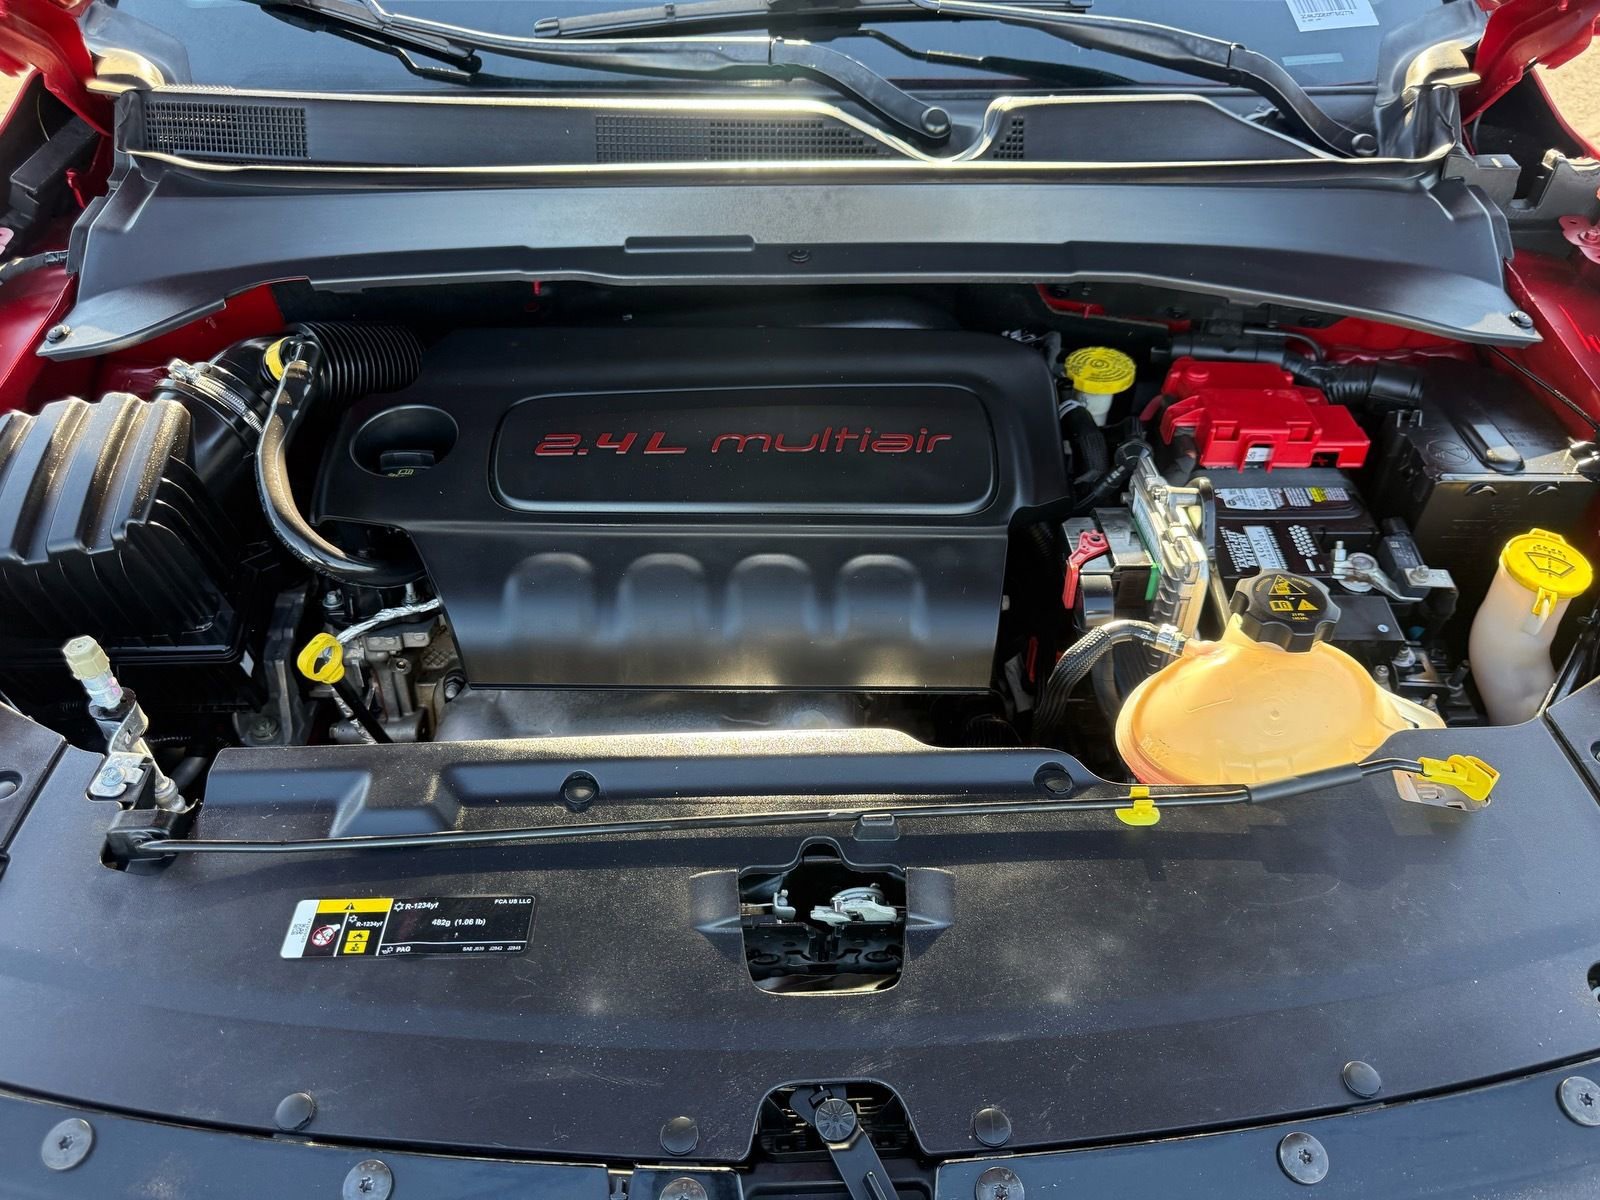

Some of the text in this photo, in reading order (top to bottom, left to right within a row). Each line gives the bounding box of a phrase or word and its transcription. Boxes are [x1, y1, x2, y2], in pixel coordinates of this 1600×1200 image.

[534, 426, 953, 456] 2.4L multiair
[1237, 531, 1259, 567] BATTERY
[1252, 538, 1268, 559] AGM
[404, 902, 439, 911] R-1234yf
[431, 918, 487, 927] 482g (1.06 lb)
